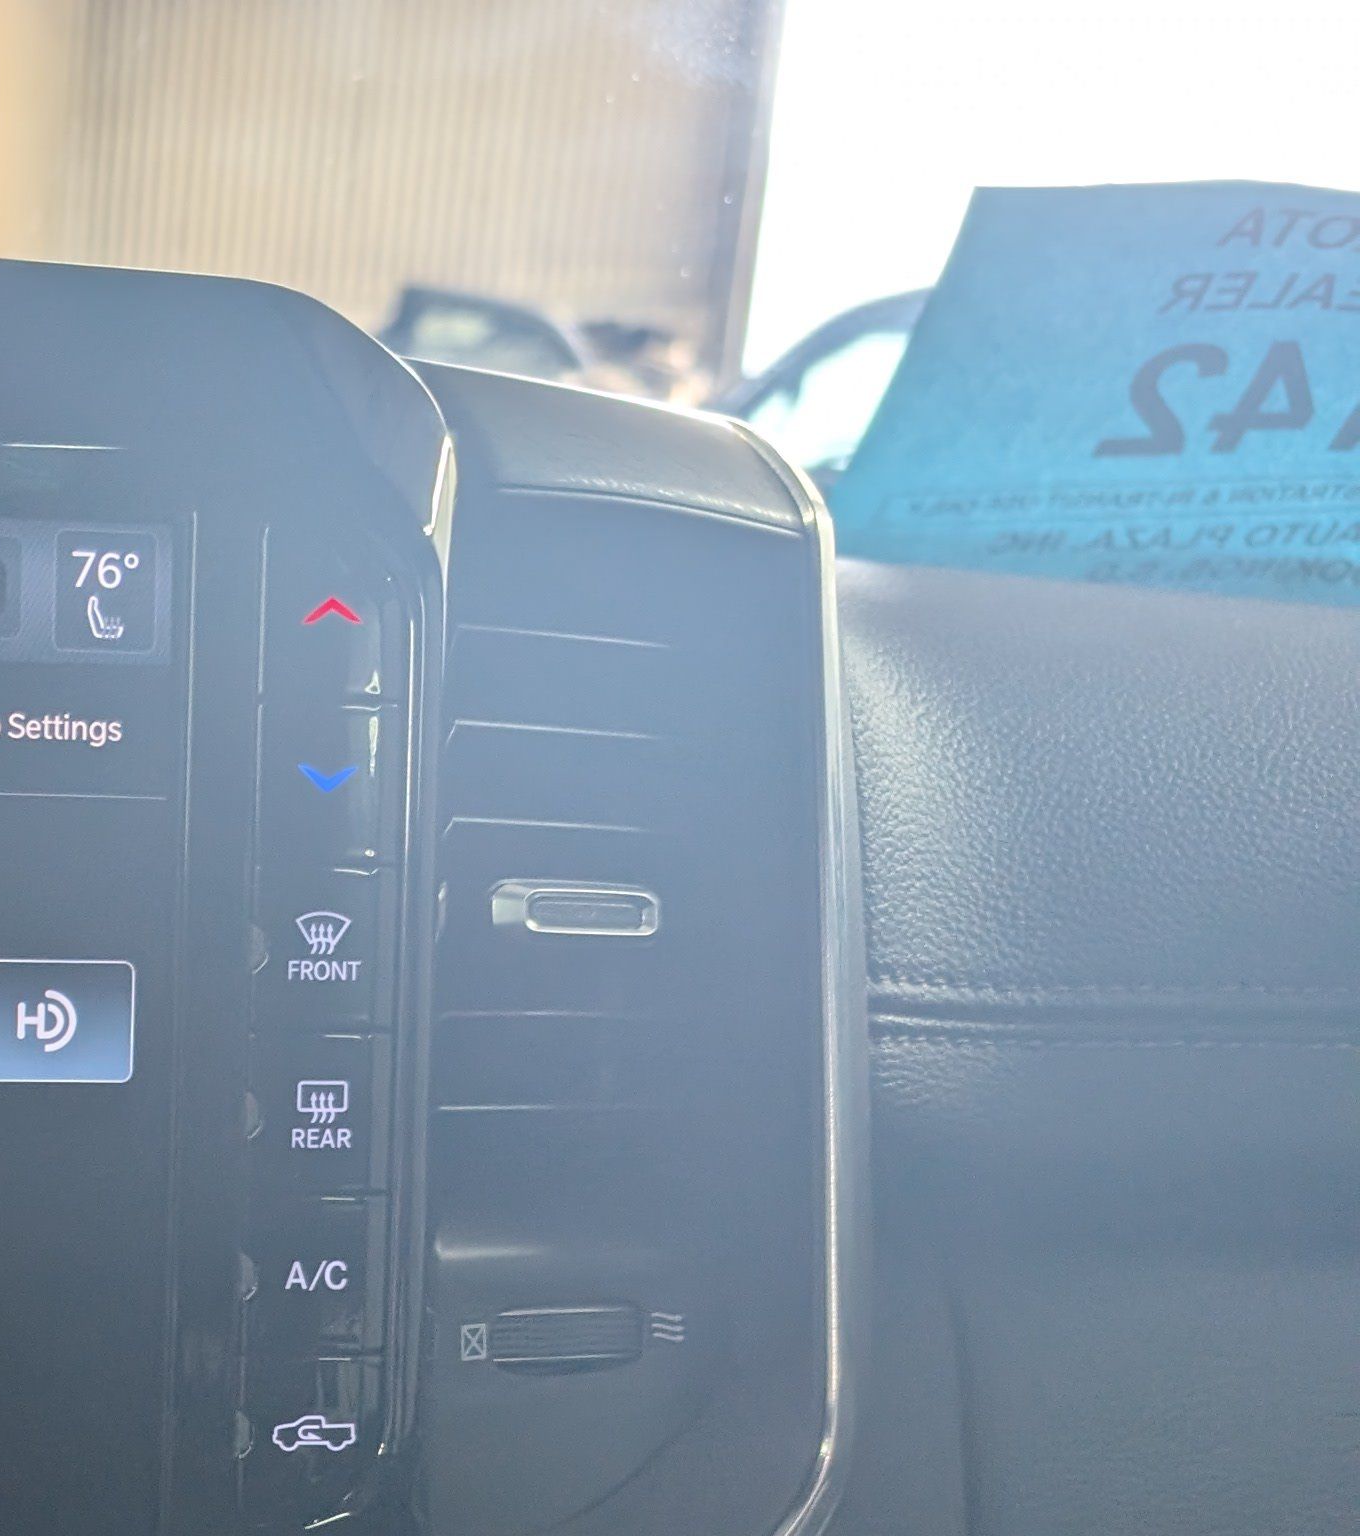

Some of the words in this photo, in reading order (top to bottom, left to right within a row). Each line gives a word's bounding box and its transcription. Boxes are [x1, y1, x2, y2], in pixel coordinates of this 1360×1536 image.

[71, 550, 140, 588] 76°
[7, 711, 123, 744] Settings
[287, 960, 361, 982] FRONT
[290, 1128, 351, 1149] REAR
[284, 1260, 349, 1292] A/C
